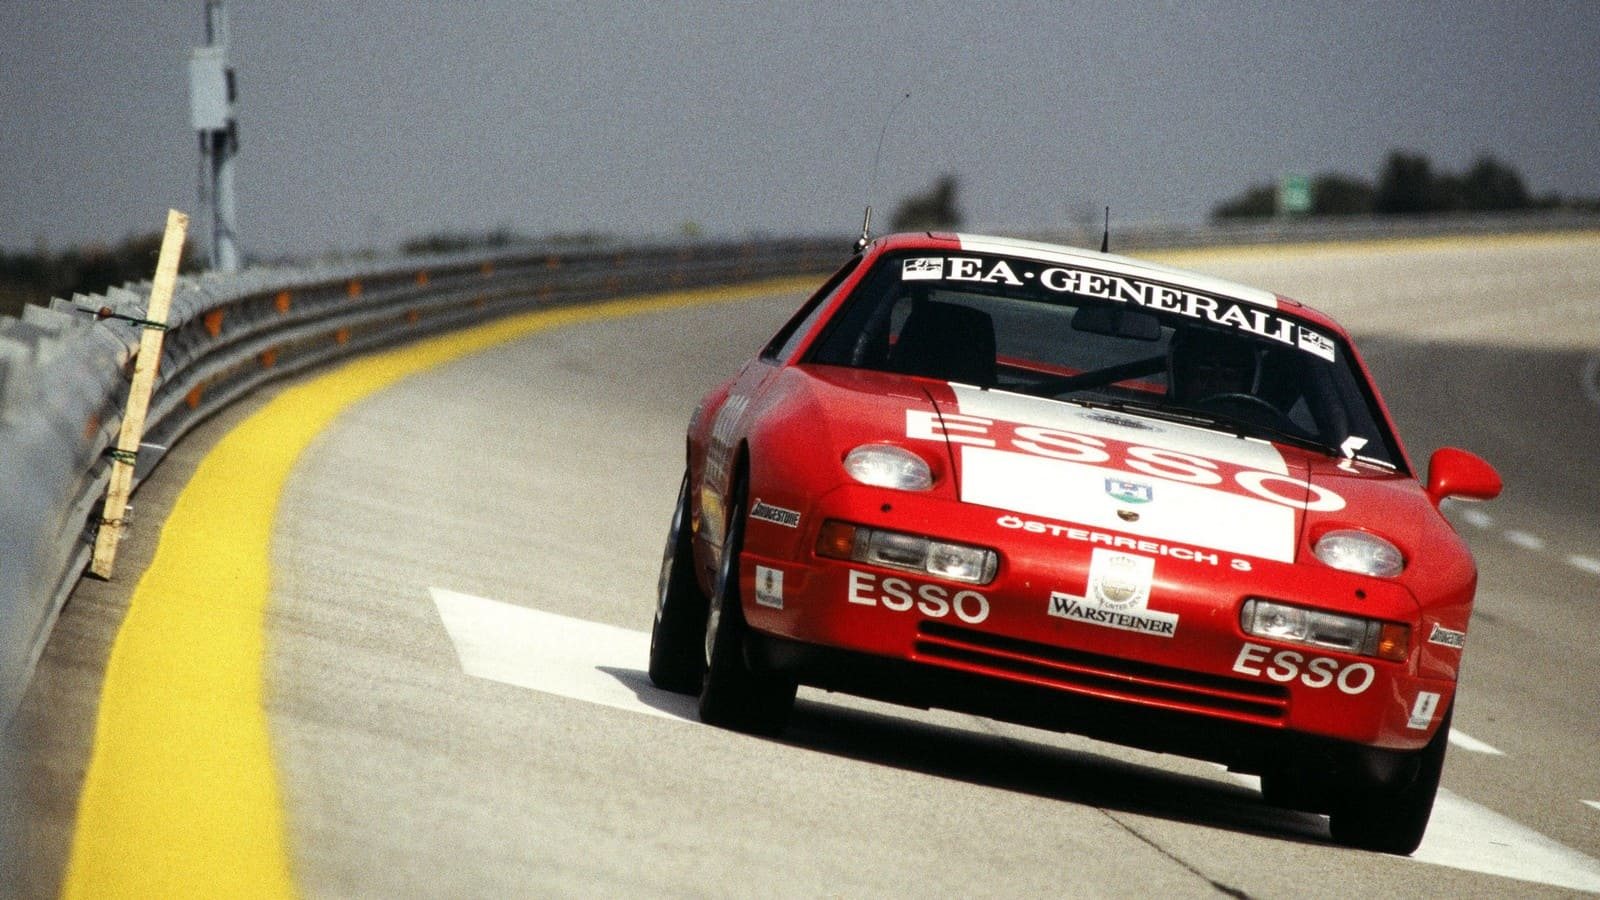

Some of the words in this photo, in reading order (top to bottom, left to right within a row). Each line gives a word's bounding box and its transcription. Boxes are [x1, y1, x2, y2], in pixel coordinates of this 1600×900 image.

[906, 410, 1346, 512] ESSO
[997, 515, 1220, 565] ÖSTERREICH
[1231, 559, 1252, 572] 3
[848, 570, 990, 624] ESSO
[1233, 643, 1375, 695] ESSO
